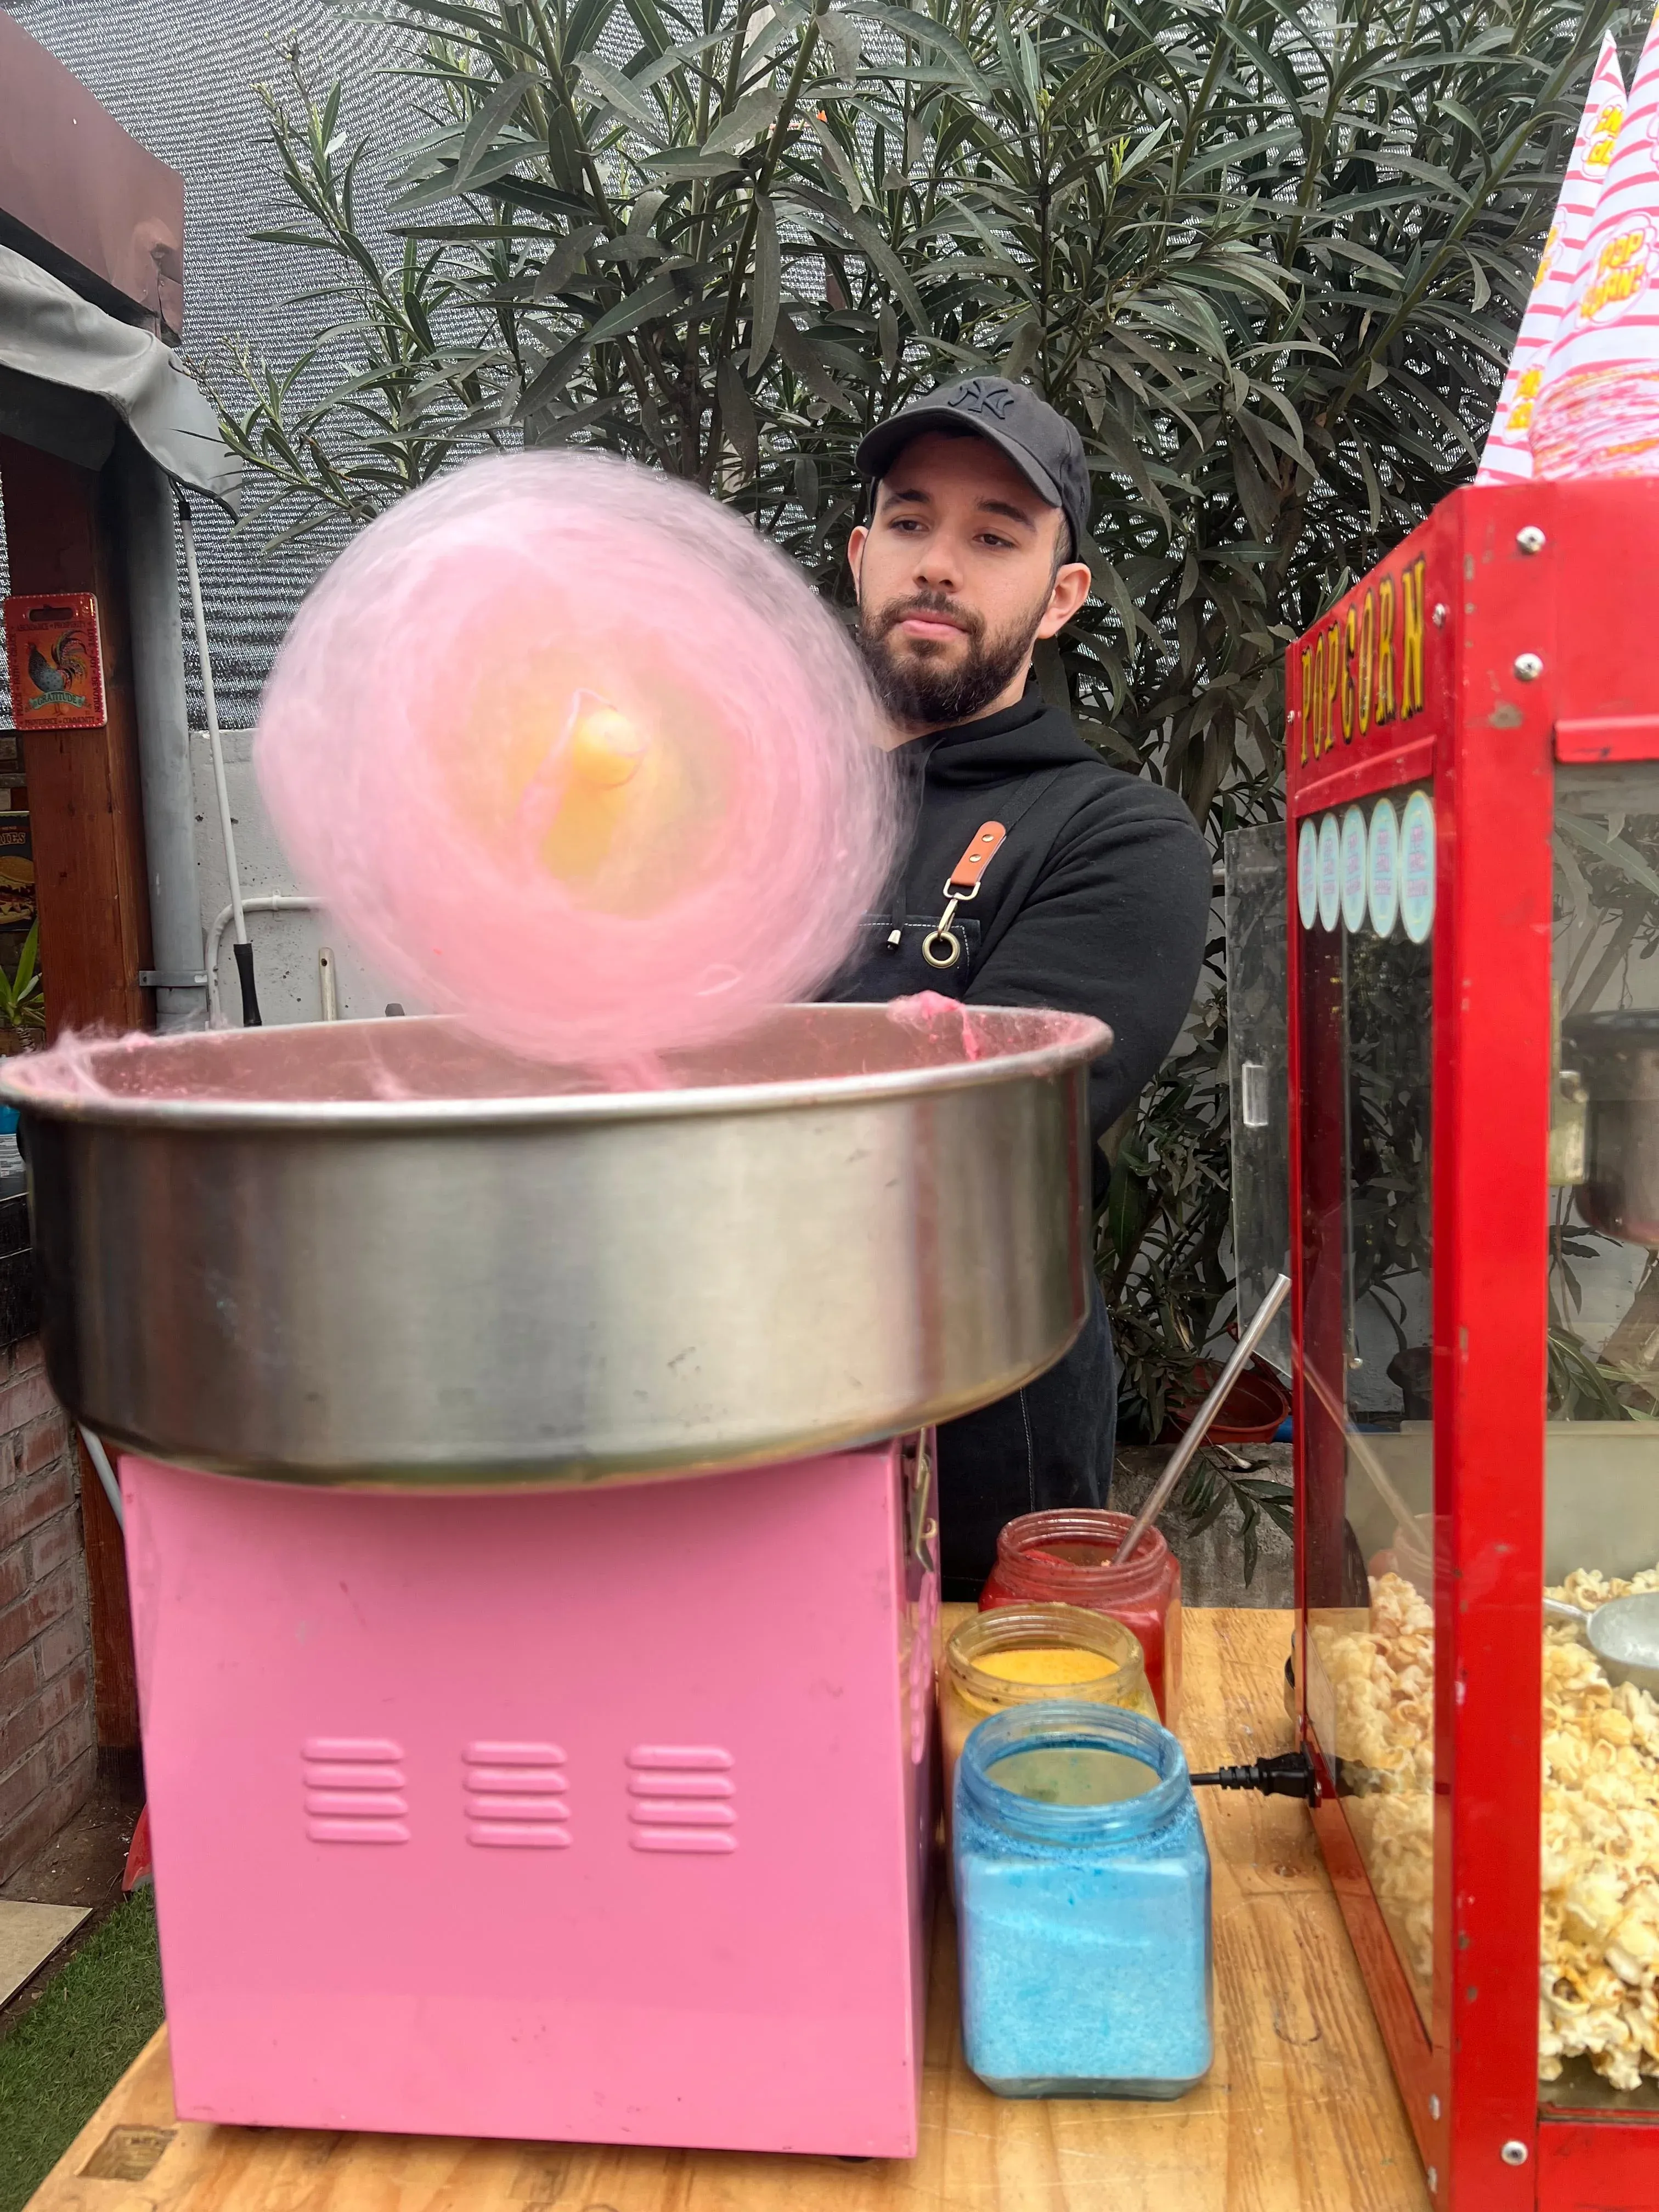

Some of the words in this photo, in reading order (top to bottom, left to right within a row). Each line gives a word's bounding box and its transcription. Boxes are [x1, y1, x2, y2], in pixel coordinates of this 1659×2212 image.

[1598, 229, 1645, 279] POP
[13, 664, 21, 685] FAITH
[1301, 551, 1426, 768] POPCORN
[37, 691, 77, 706] GRATITUDE
[91, 676, 101, 713] DEVOTION
